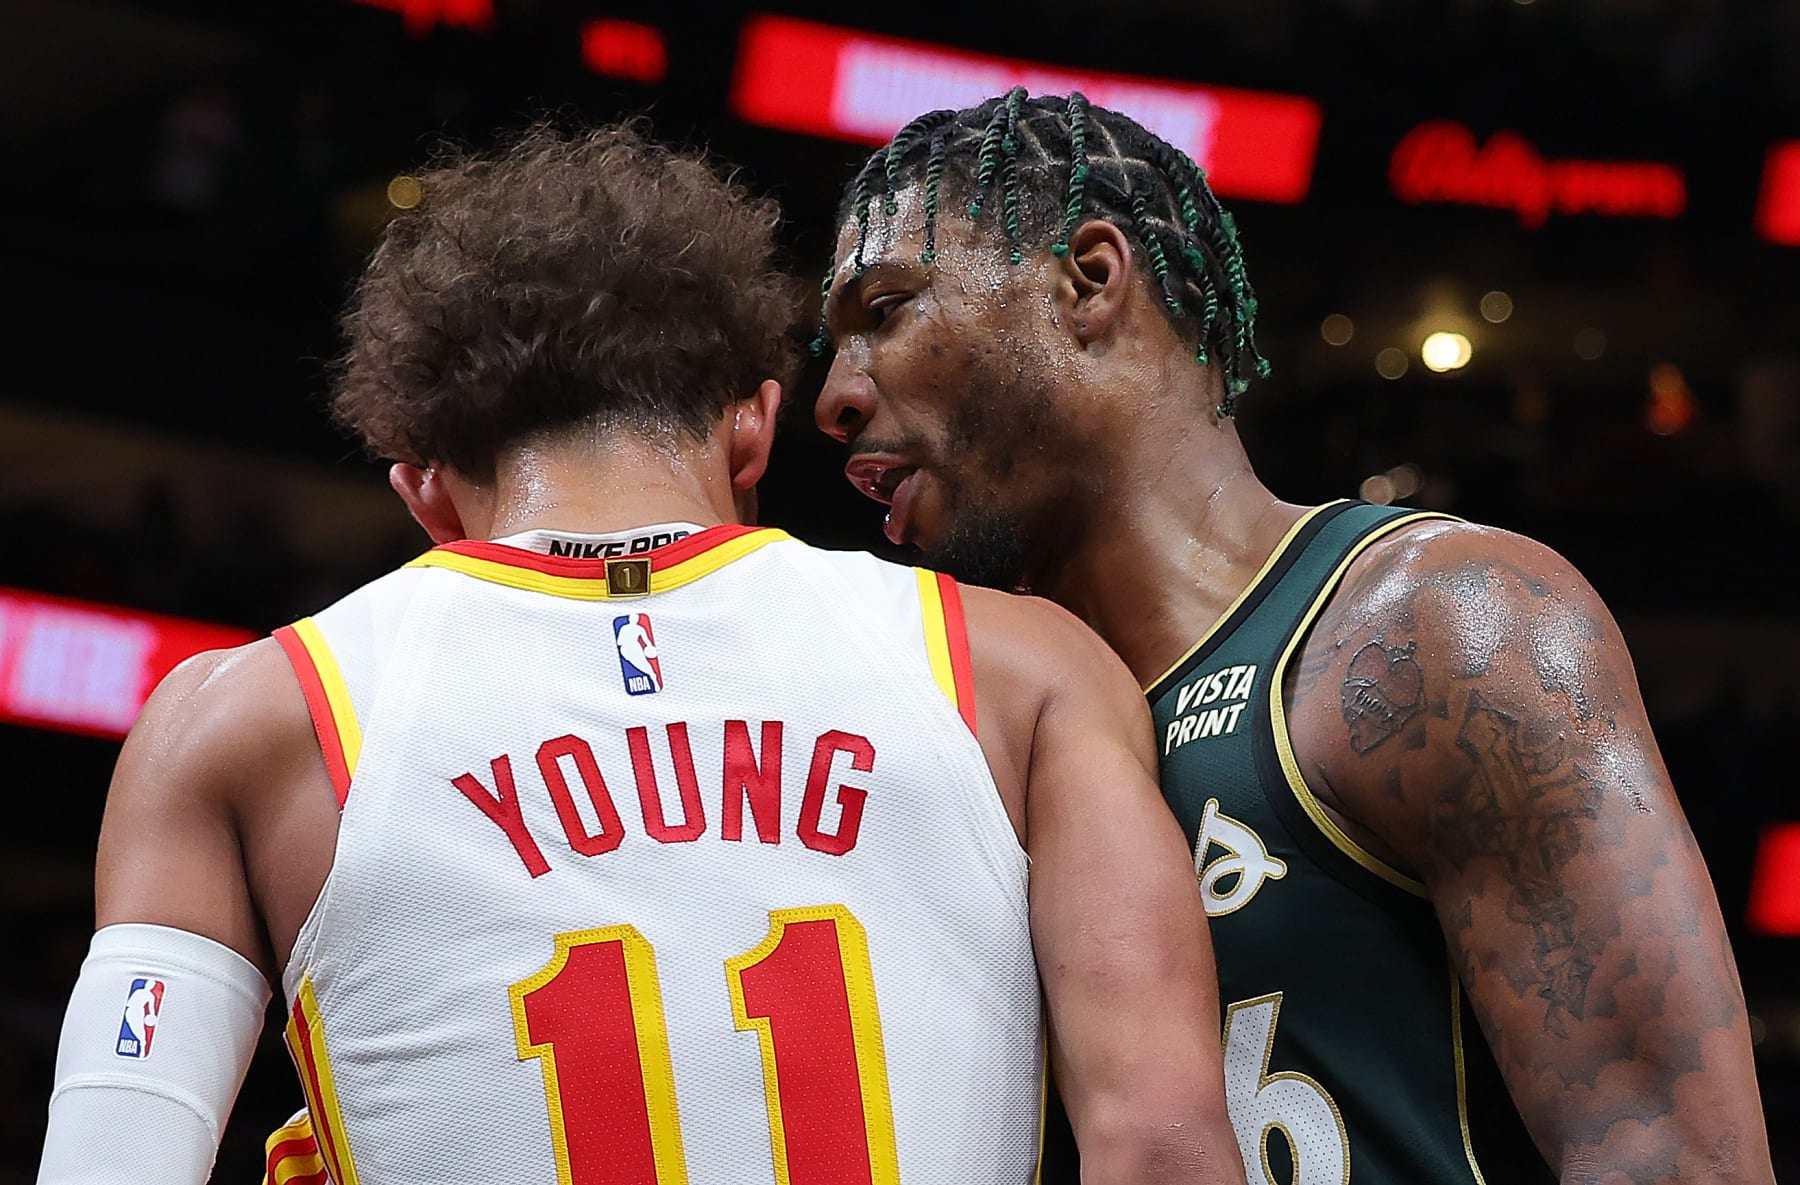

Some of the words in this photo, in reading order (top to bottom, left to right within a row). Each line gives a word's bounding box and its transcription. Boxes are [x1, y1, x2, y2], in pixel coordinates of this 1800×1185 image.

[549, 540, 625, 558] NIKE
[628, 676, 651, 692] NBA
[1175, 664, 1257, 717] VISTA
[1165, 702, 1247, 756] PRINT
[451, 720, 876, 878] YOUNG
[118, 1039, 138, 1054] NBA
[507, 904, 899, 1185] 11
